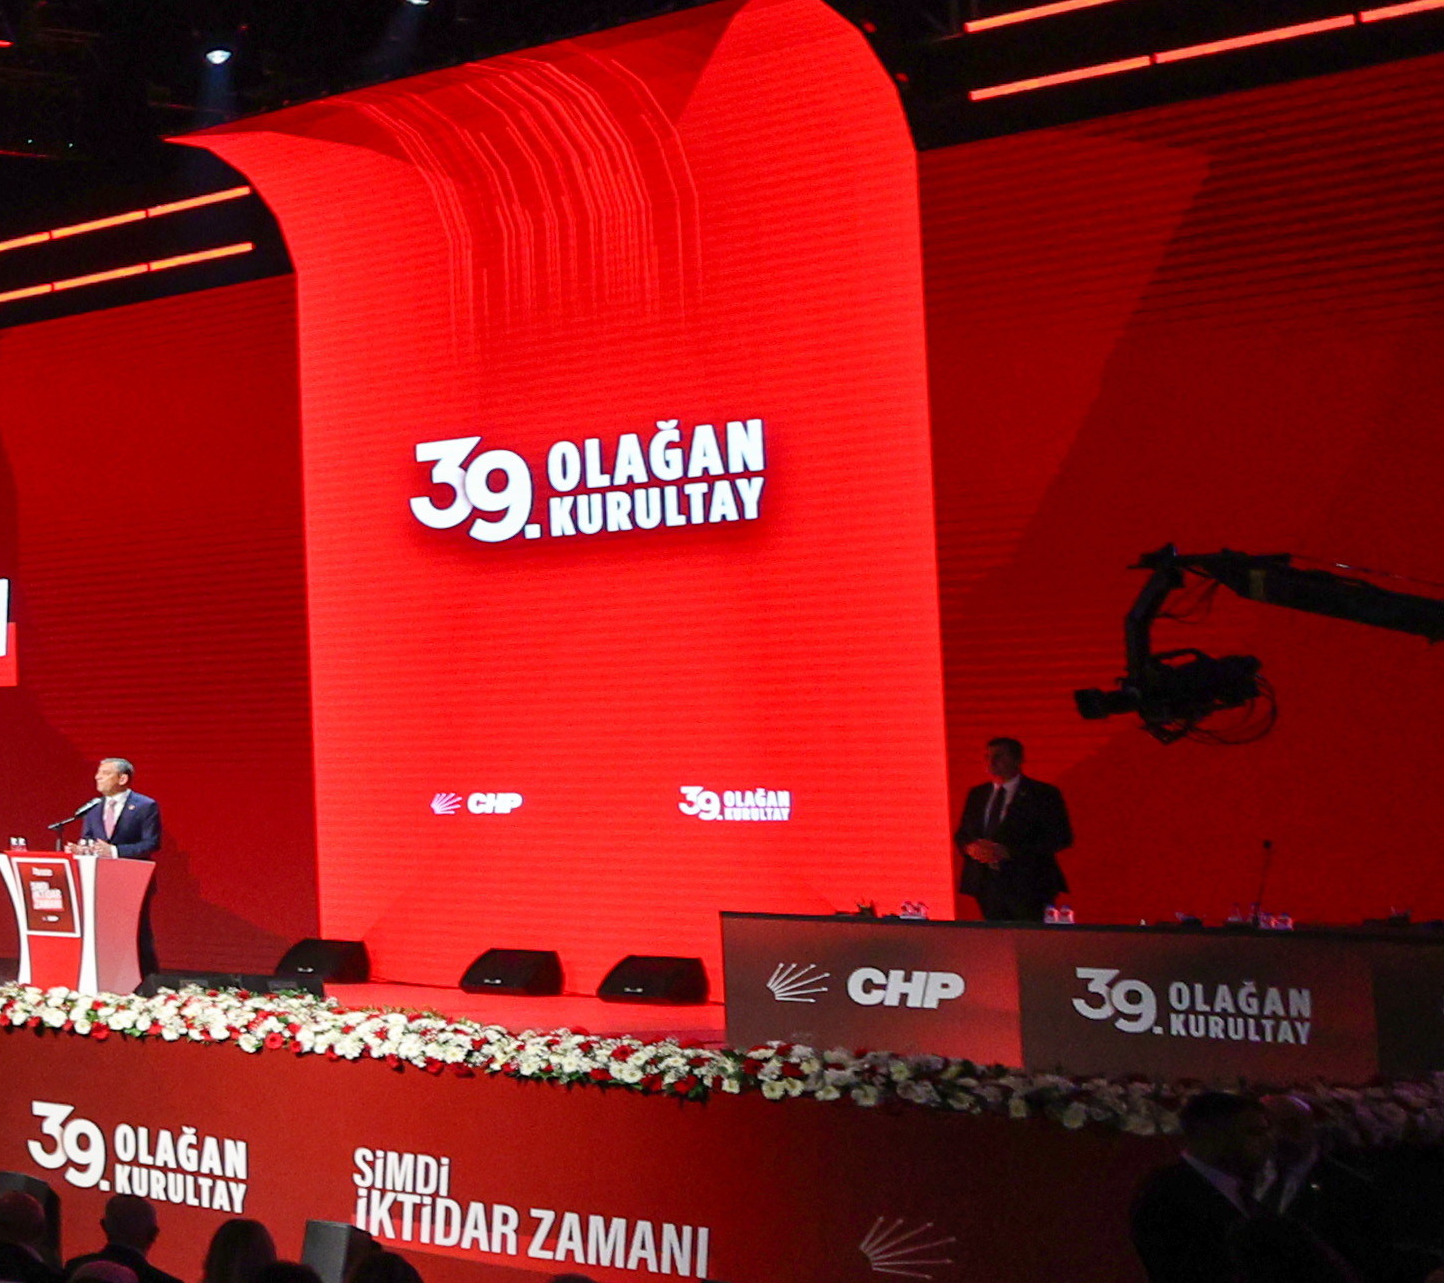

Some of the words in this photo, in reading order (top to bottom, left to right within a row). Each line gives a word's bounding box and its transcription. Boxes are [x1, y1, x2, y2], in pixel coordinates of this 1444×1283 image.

[410, 436, 542, 543] 39.
[546, 418, 765, 492] OLAĞAN
[548, 476, 765, 536] KURULTAY
[468, 792, 522, 814] CHP
[723, 788, 791, 808] OLAĞAN
[847, 966, 965, 1009] CHP
[1072, 966, 1163, 1034] 39.
[1168, 979, 1311, 1018] OLAĞAN
[1169, 1012, 1311, 1045] KURULTAY
[27, 1100, 111, 1192] 39.
[113, 1124, 248, 1180] OLAĞAN
[114, 1163, 248, 1214] KURULTAY
[527, 1207, 710, 1280] ZAMANI
